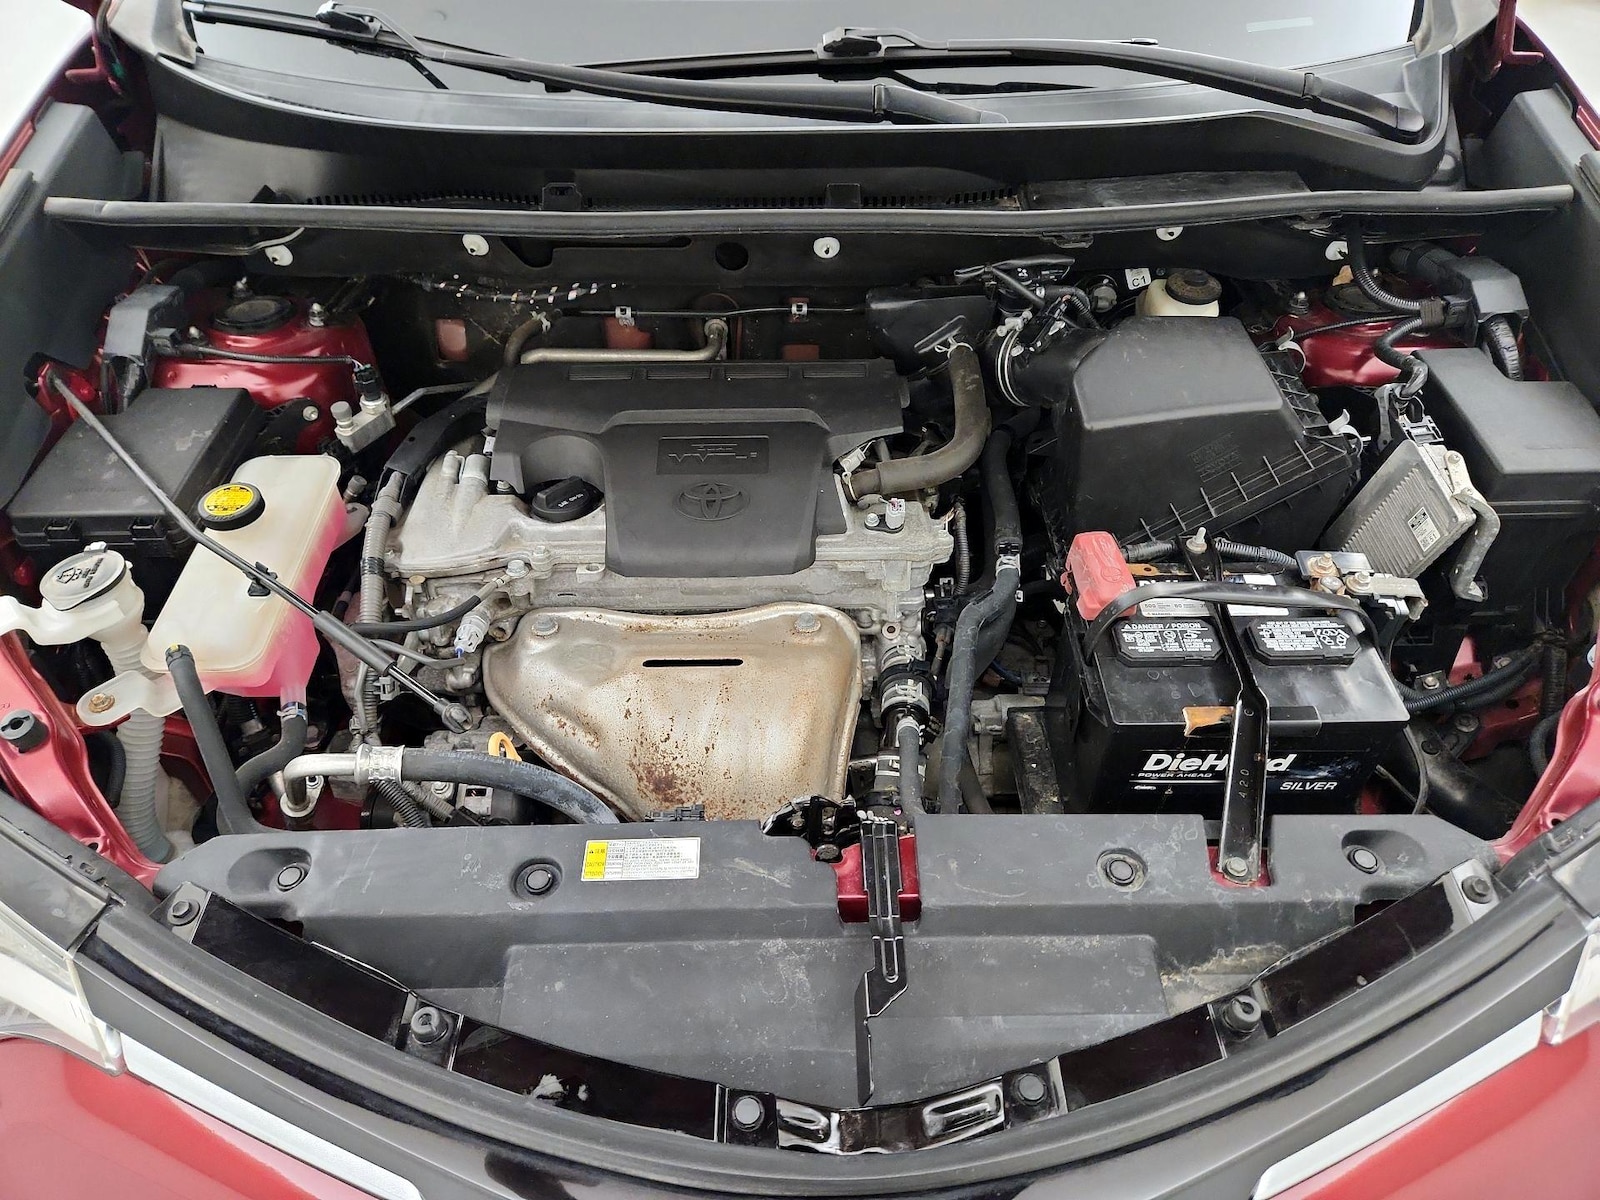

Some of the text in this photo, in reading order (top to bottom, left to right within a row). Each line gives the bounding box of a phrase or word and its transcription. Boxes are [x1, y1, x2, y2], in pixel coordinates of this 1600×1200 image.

[1132, 275, 1147, 287] C1
[1171, 622, 1202, 630] POISON
[1142, 753, 1298, 772] DieHd
[1279, 781, 1338, 791] SILVER
